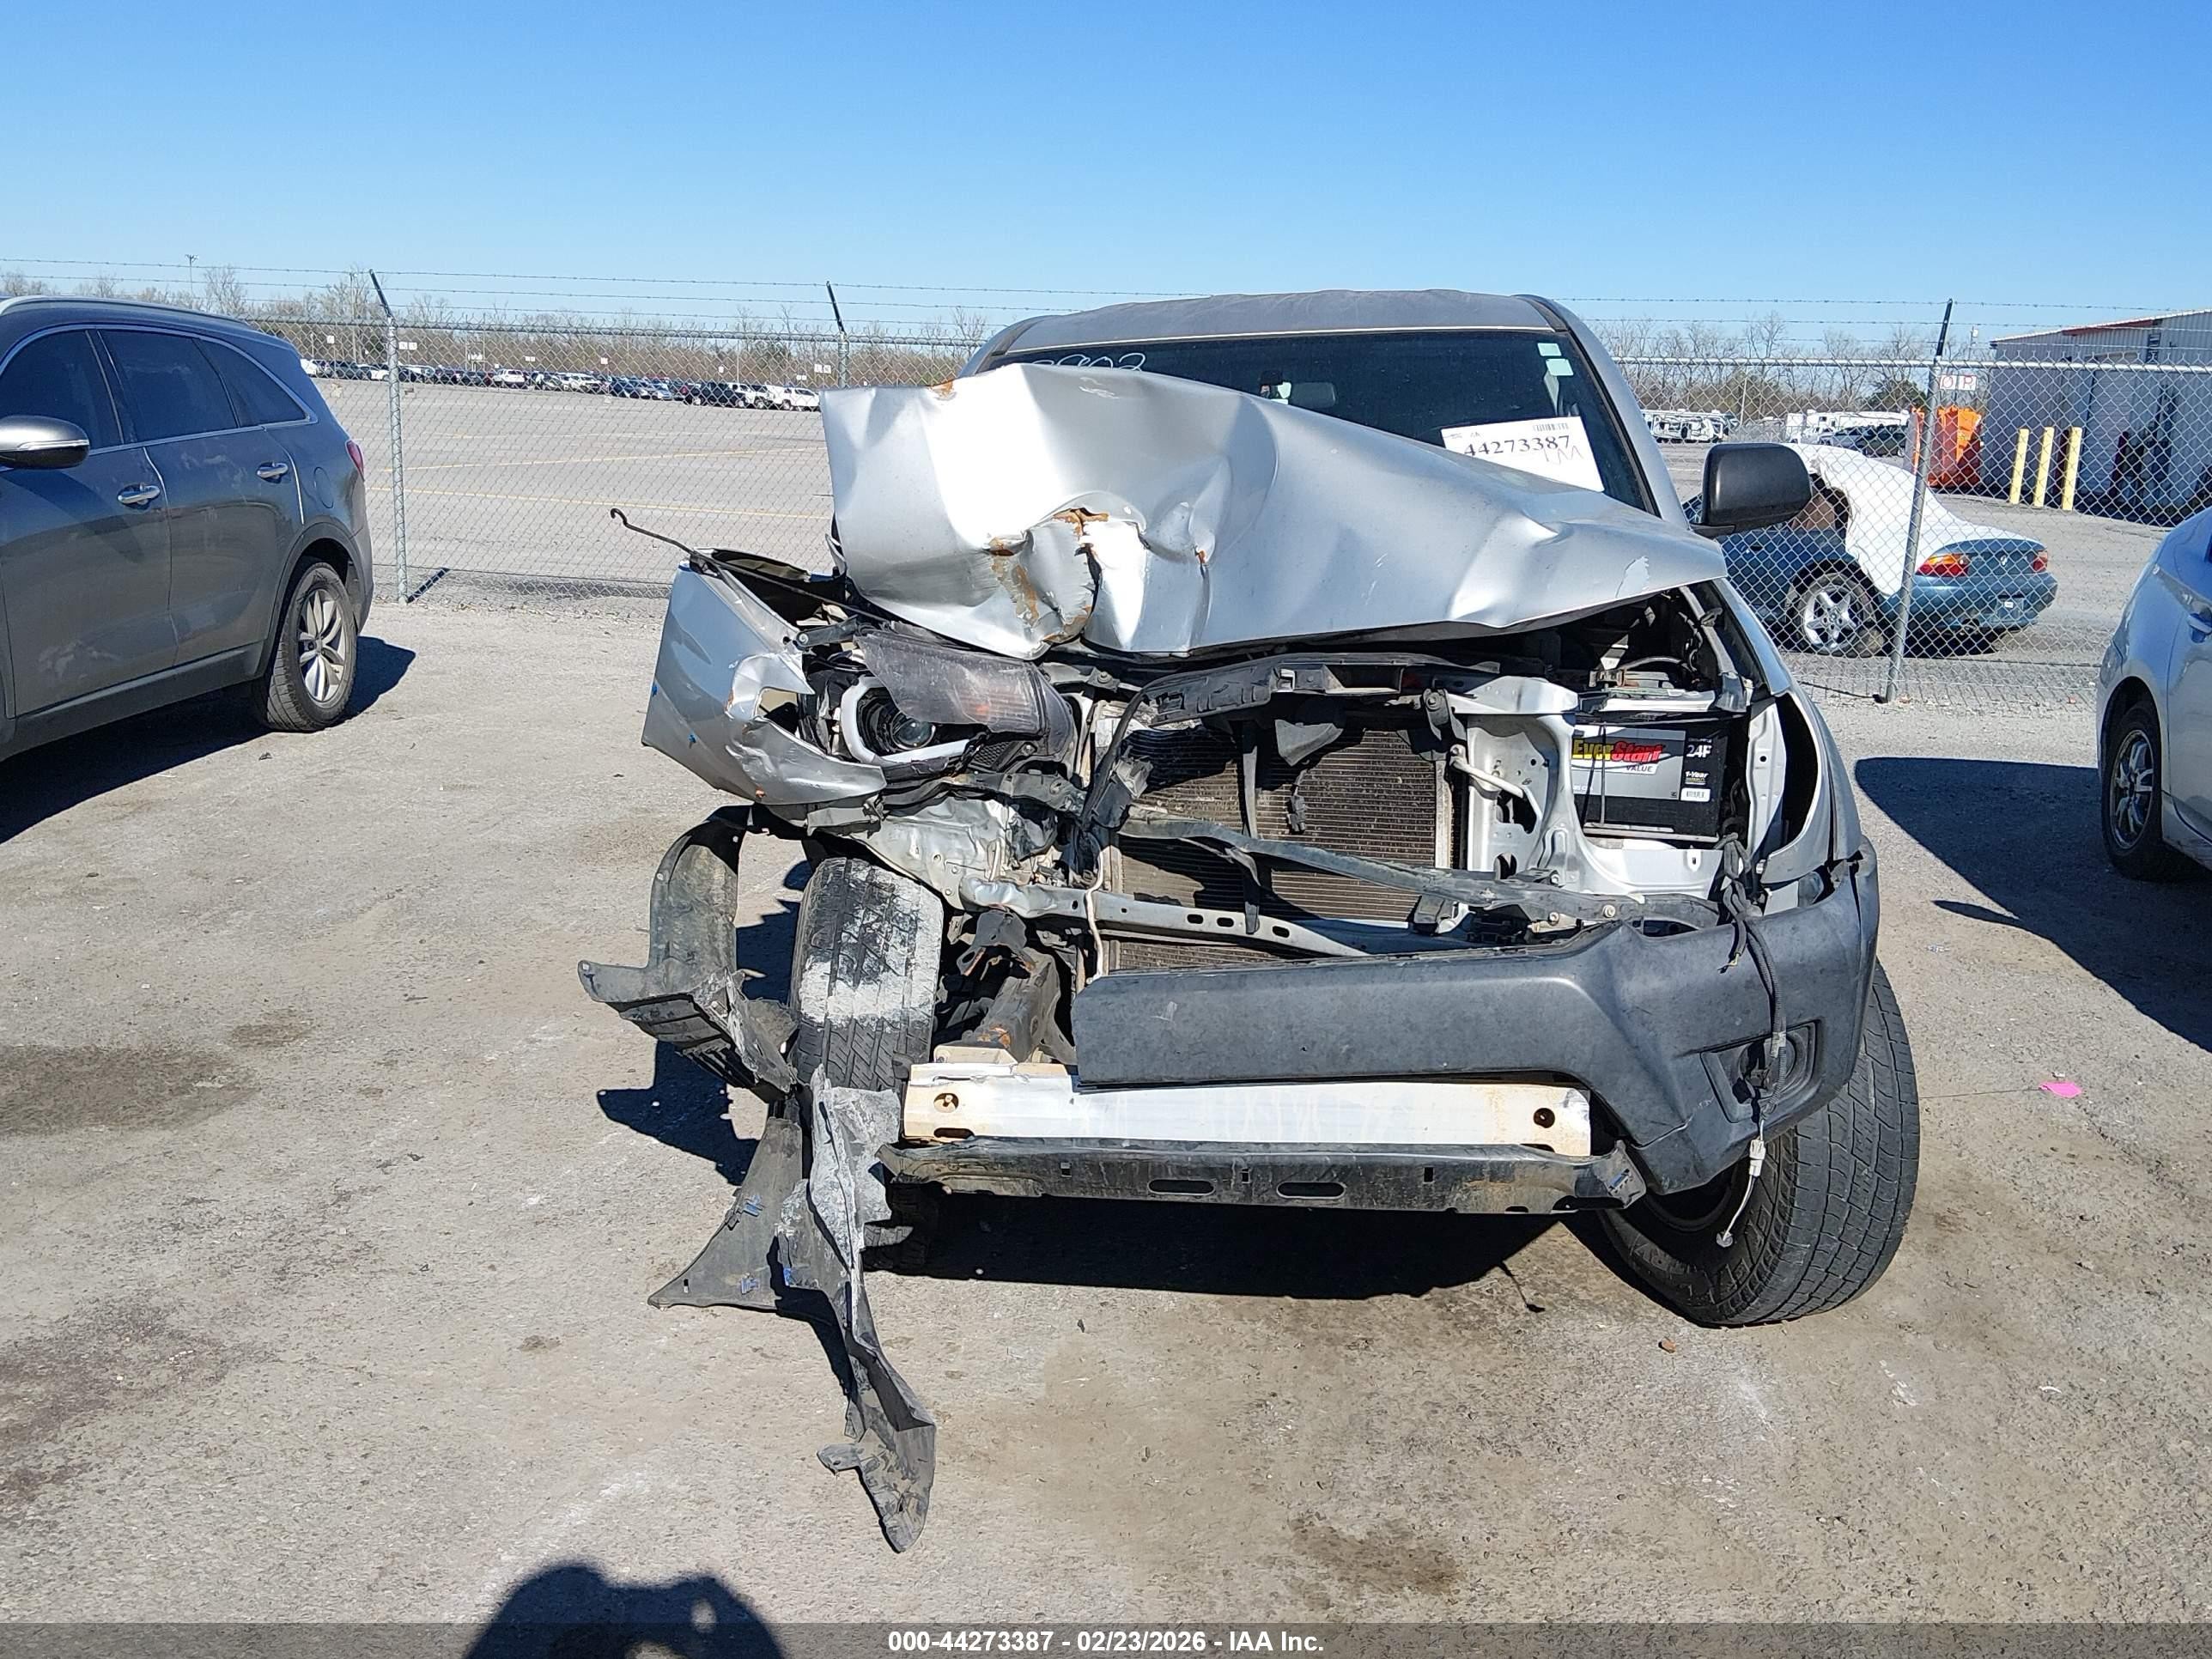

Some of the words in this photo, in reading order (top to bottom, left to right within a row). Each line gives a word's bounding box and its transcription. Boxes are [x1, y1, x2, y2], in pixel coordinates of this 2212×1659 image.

[1464, 434, 1570, 457] 44273387
[1571, 738, 1663, 763] EverStart
[1686, 744, 1712, 758] 24F
[1626, 763, 1652, 772] VALUE
